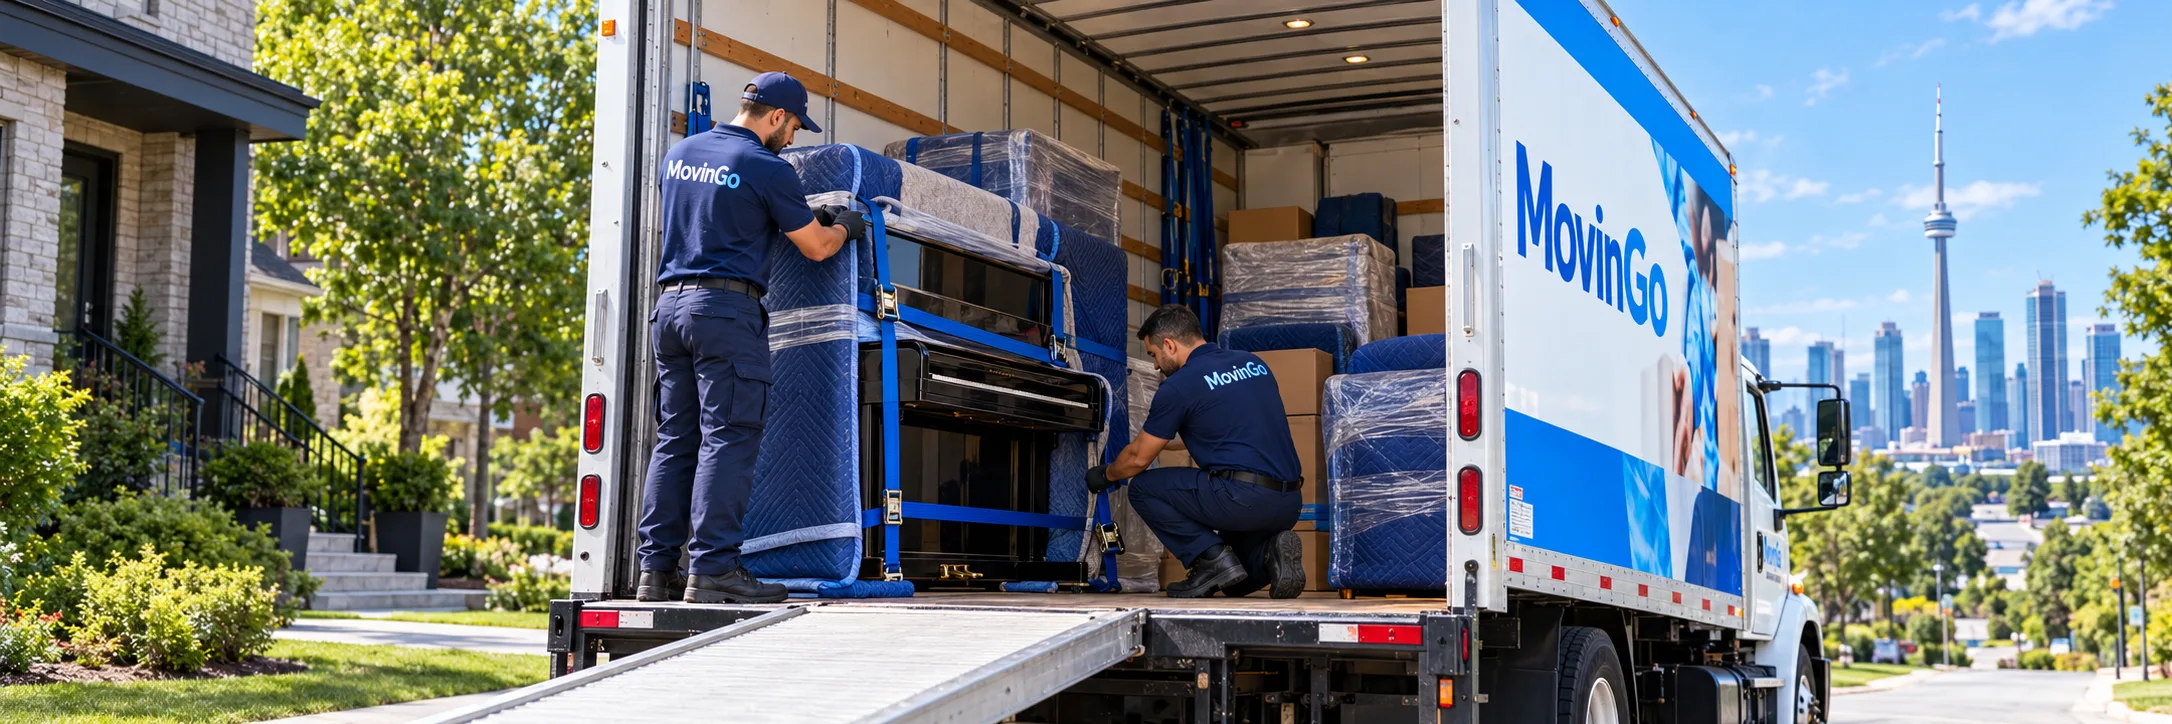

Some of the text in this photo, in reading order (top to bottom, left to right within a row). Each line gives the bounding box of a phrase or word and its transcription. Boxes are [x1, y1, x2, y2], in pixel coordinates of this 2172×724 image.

[666, 159, 741, 189] MovinGo
[1516, 140, 1668, 337] MovinGo
[1203, 361, 1268, 390] MovinGo
